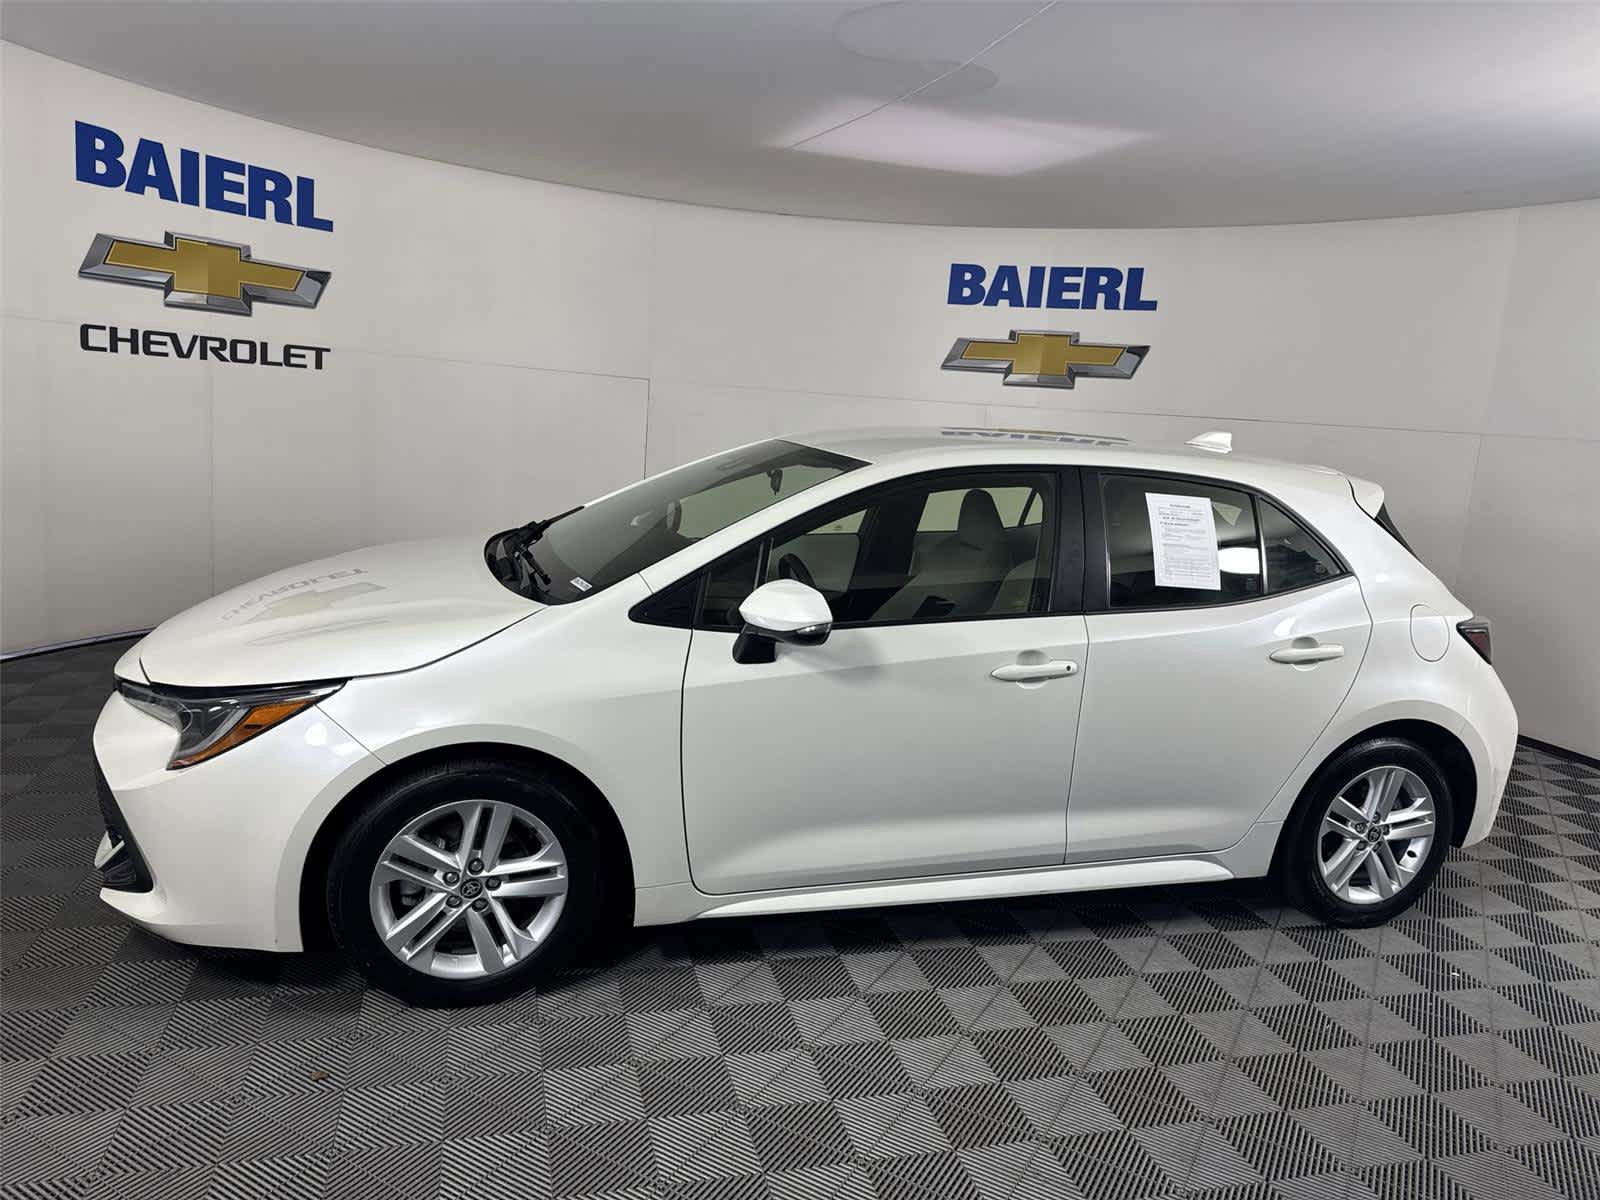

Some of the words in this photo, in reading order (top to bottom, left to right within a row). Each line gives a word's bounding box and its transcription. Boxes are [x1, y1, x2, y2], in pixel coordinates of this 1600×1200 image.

[75, 120, 334, 232] BAIERL
[947, 263, 1158, 311] BAIERL
[80, 323, 331, 370] CHEVROLET
